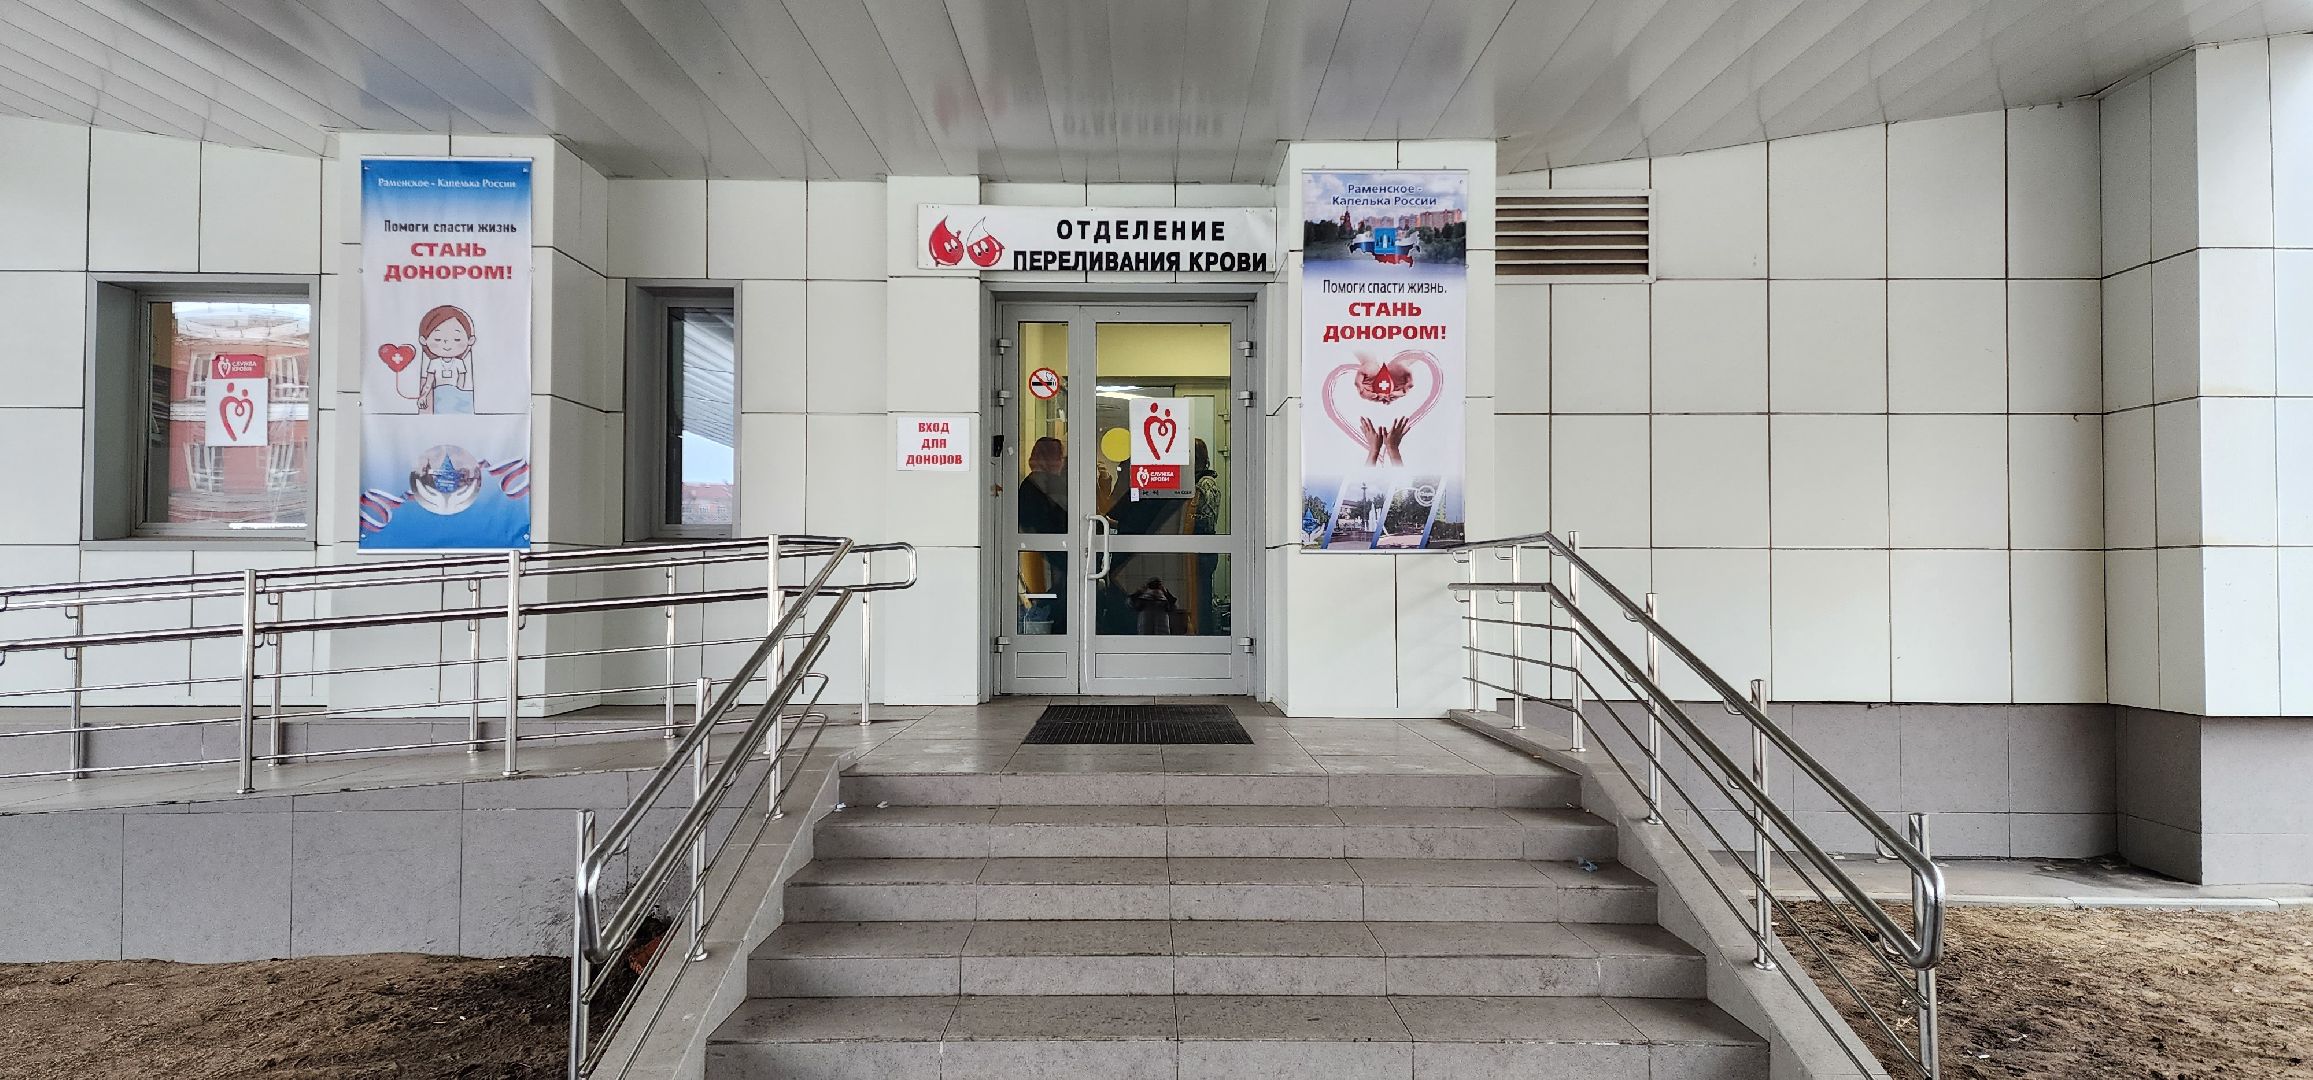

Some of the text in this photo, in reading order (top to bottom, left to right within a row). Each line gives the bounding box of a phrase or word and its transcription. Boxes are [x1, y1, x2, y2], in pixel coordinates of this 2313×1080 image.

[378, 178, 430, 188] Раменское
[437, 178, 481, 188] Капелька
[482, 179, 517, 188] России
[1347, 184, 1415, 194] Раменское
[1332, 196, 1437, 206] Капелька России
[384, 219, 517, 233] Помоги спасти жизнь
[1056, 219, 1226, 243] ОТДЕЛЕНИЕ
[410, 242, 487, 258] СТАНЬ
[1013, 250, 1267, 272] ПЕРЕЛИВАНИЯ КРОВИ
[383, 264, 513, 282] ДОНОРОМ!
[1323, 279, 1447, 294] Помоги спасти жизнь.
[1348, 302, 1422, 317] СТАНЬ
[1322, 325, 1447, 343] ДОНОРОМ!
[918, 422, 950, 435] ВХОД
[921, 438, 947, 450] ДЛЯ
